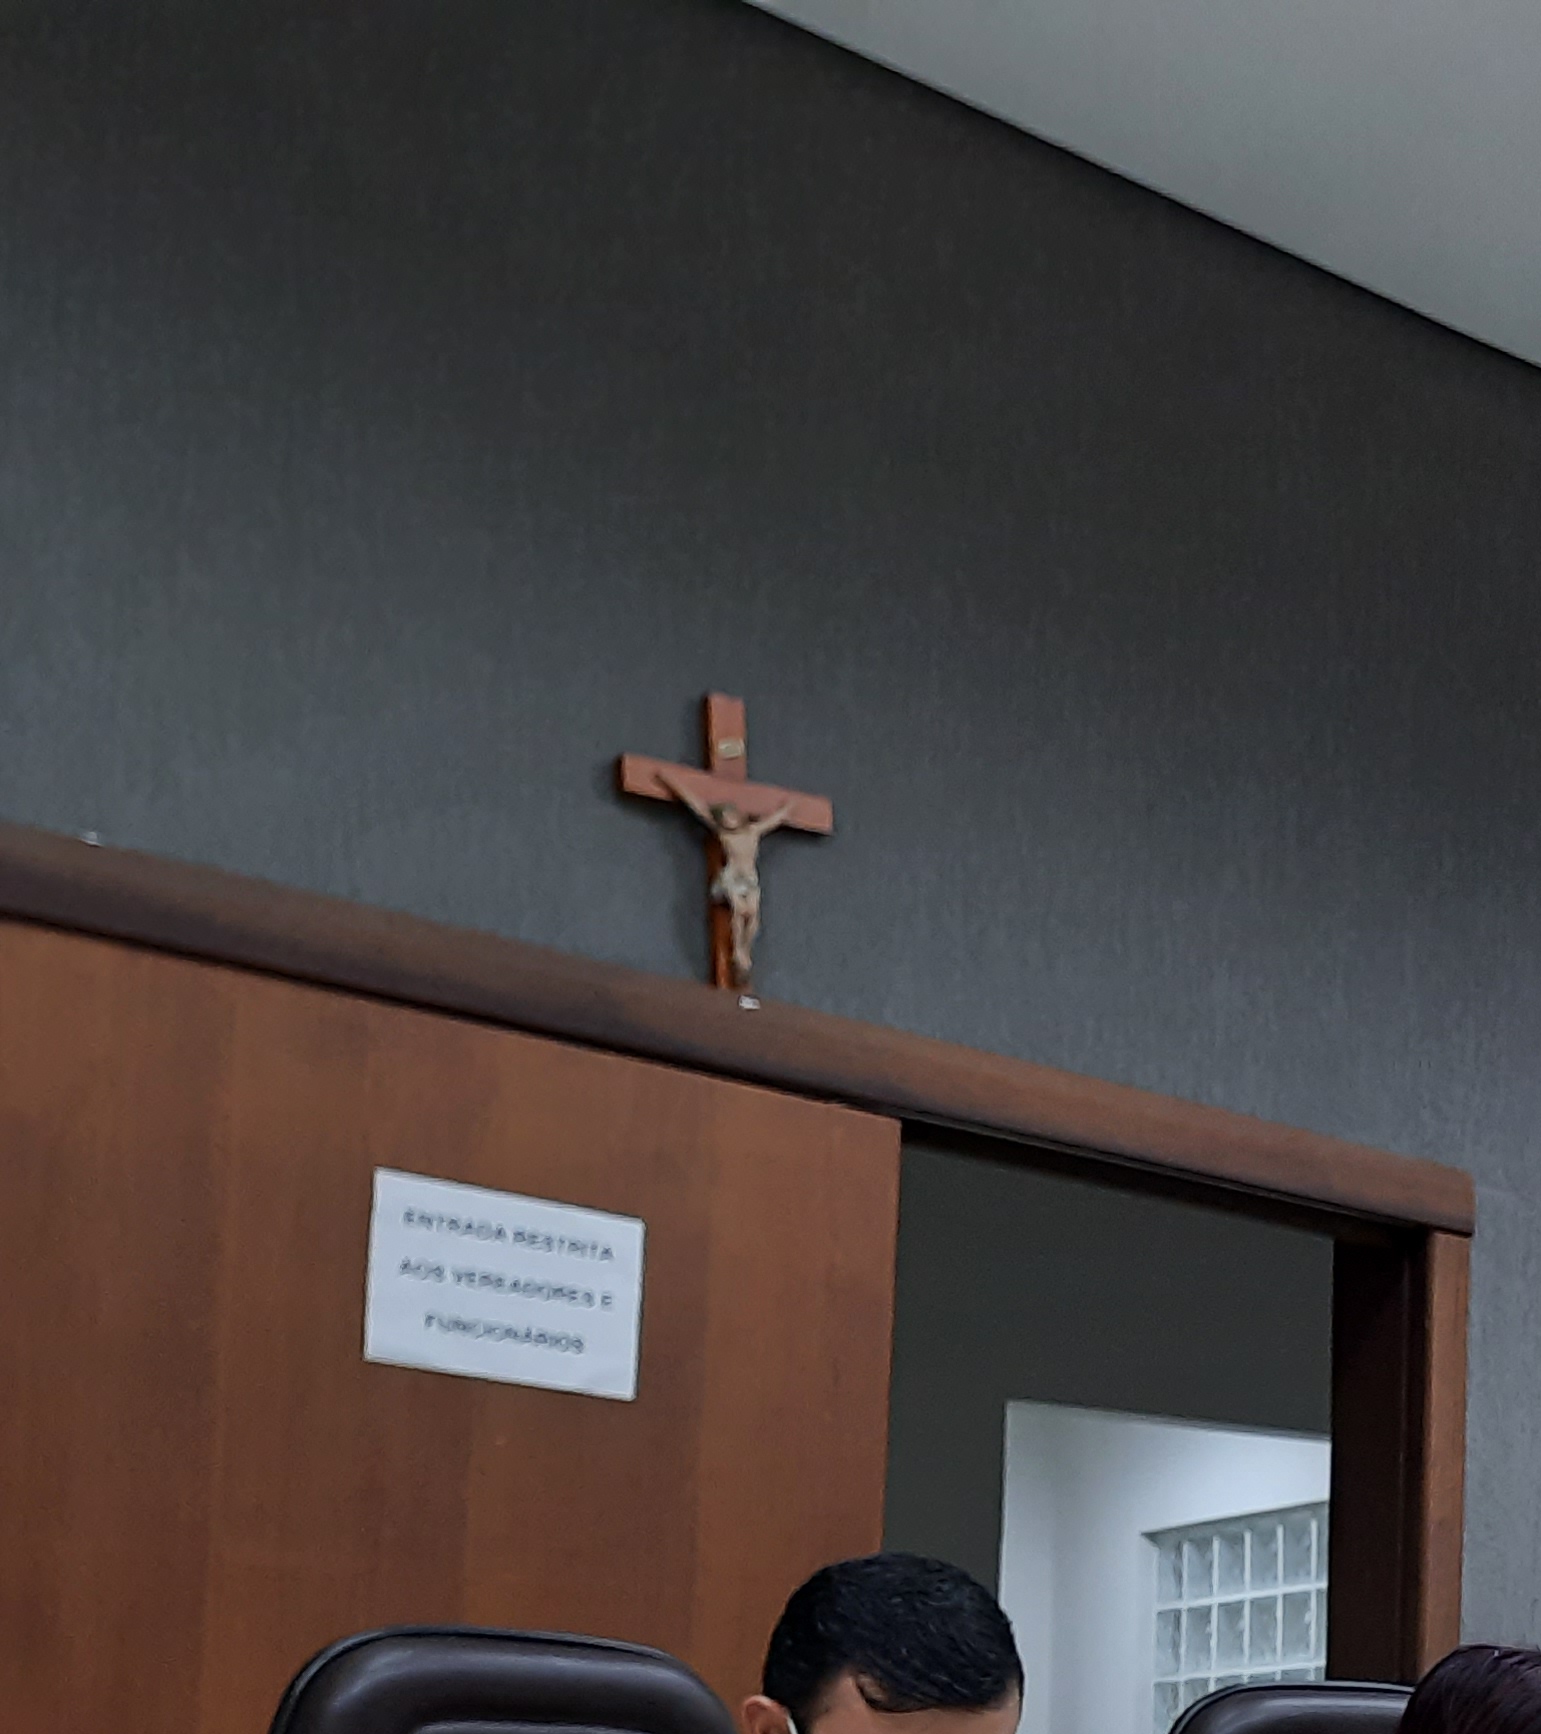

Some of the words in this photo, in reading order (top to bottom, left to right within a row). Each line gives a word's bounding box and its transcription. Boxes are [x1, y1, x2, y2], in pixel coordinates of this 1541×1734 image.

[403, 1207, 507, 1241] ENTRADA
[512, 1228, 615, 1262] RESTRITA
[399, 1256, 445, 1284] AOS
